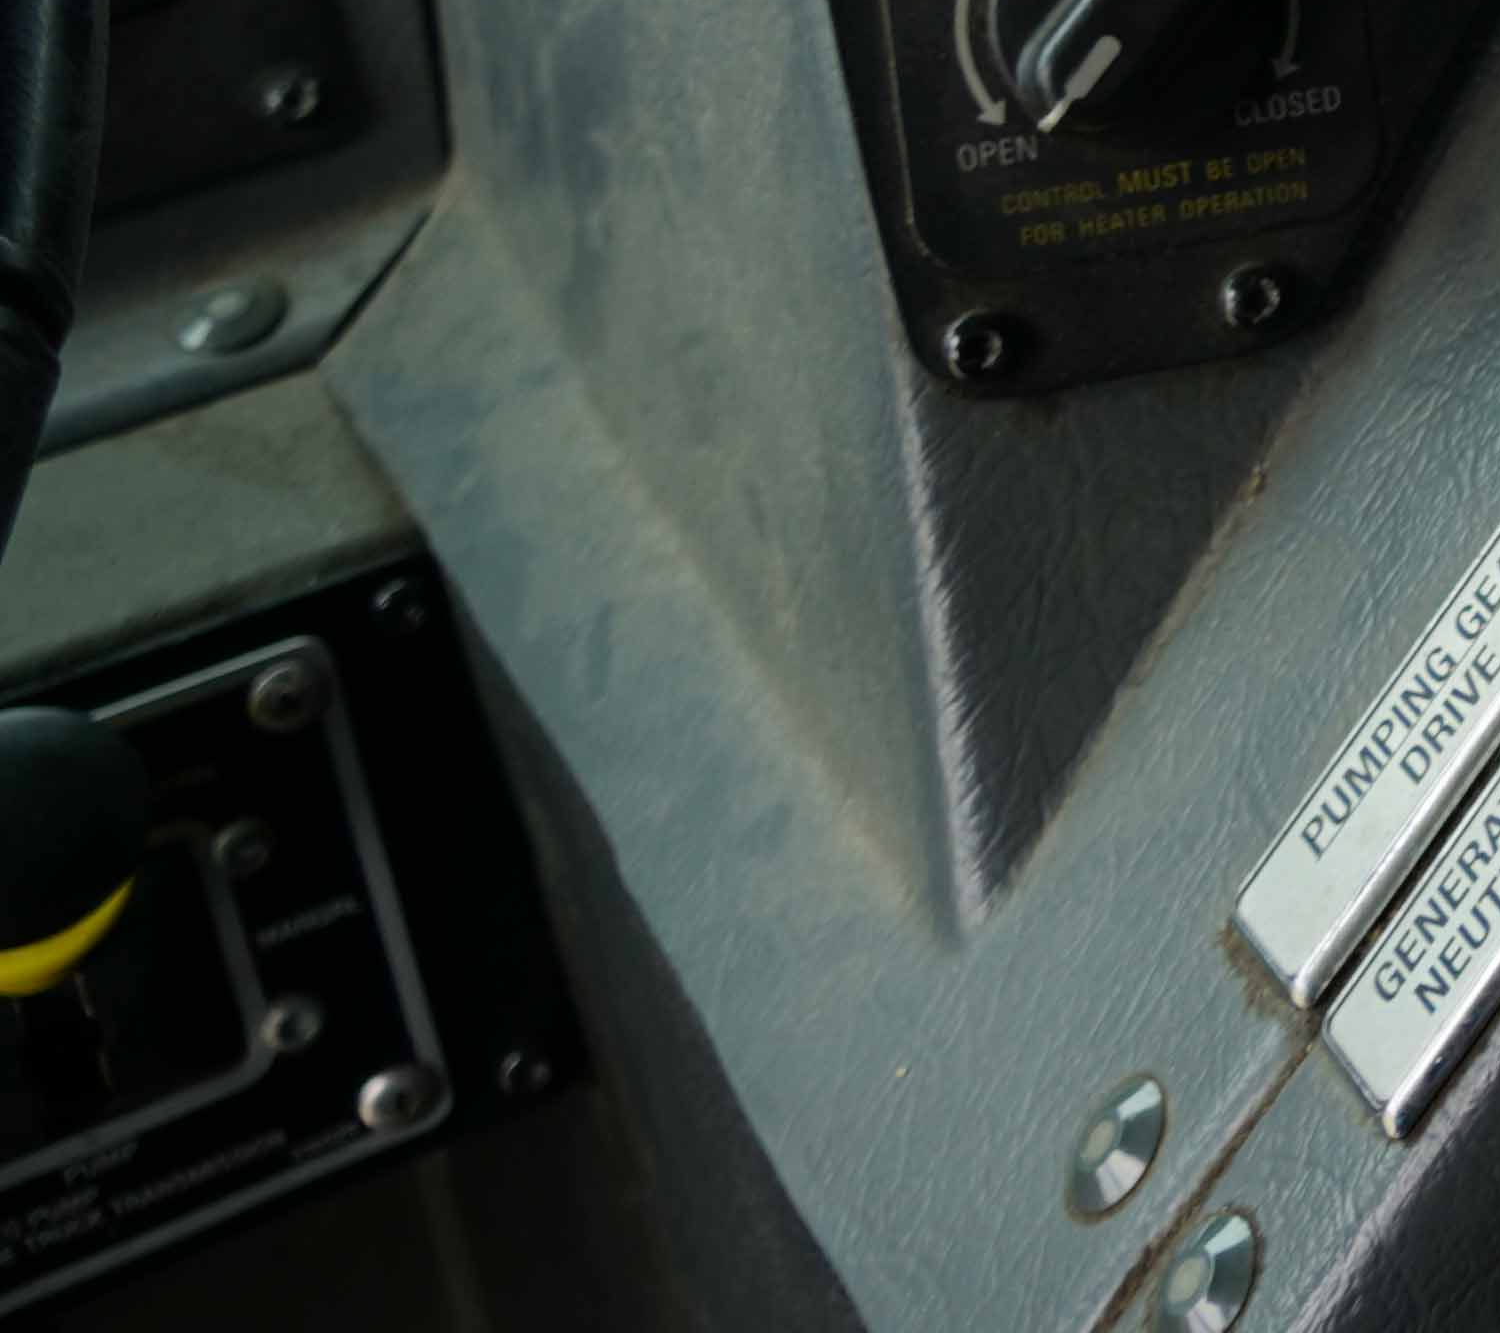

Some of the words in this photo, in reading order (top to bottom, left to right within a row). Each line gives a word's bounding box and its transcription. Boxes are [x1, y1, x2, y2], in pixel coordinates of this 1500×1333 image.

[1234, 85, 1342, 128] CLOSED
[956, 135, 1039, 173] OPEN
[1000, 179, 1105, 215] CONTROL
[1117, 159, 1194, 195] MUST
[1206, 155, 1235, 181] BE
[1247, 146, 1307, 176] OPEN
[1021, 223, 1066, 247] FOR
[1080, 204, 1168, 239] HEATER
[1180, 180, 1310, 220] OPERATION
[1299, 645, 1457, 860] PUMPING
